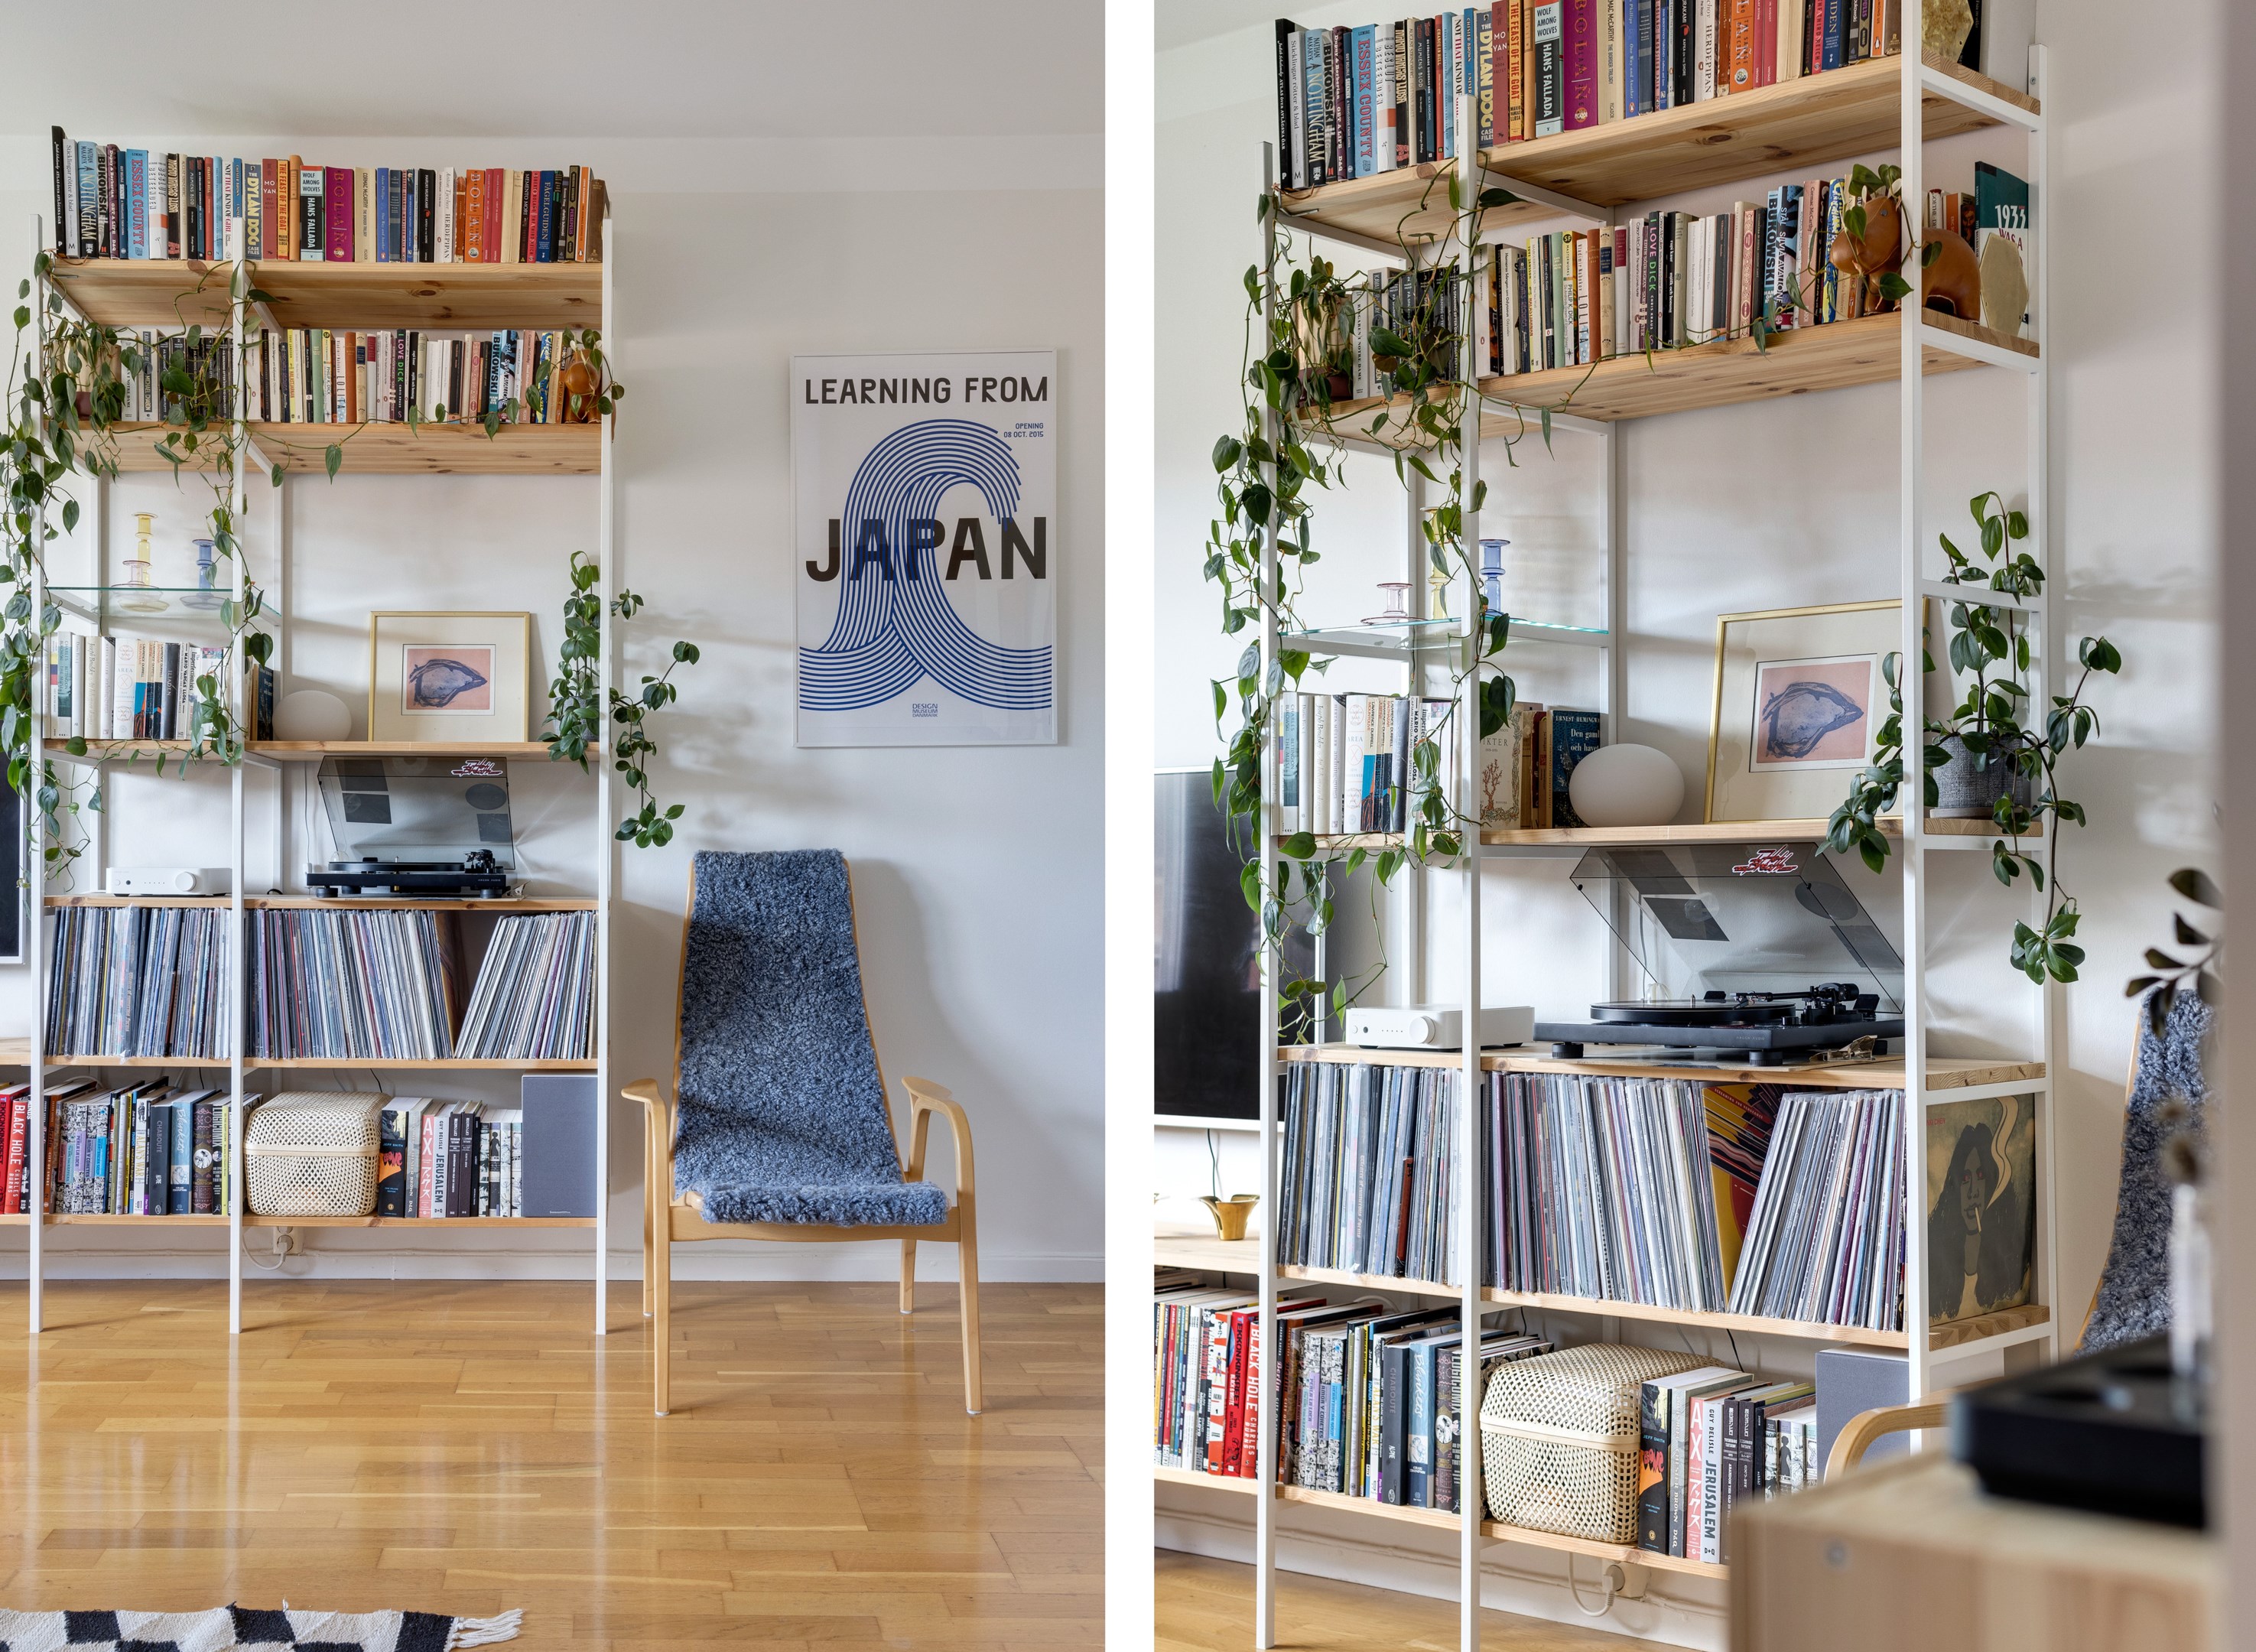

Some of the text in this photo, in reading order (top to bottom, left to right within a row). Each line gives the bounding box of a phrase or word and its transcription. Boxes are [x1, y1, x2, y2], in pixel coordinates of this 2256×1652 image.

[1491, 43, 1507, 52] YAN
[1537, 16, 1557, 26] AMONG
[1394, 29, 1406, 105] MARIO VARGAS LLOSA
[1479, 31, 1493, 86] DYLAN
[1510, 3, 1520, 99] THE FEAST OF THE GOAT
[1324, 45, 1334, 127] BUKOWSKI
[1358, 38, 1372, 158] ESSEX COUNTY
[1543, 44, 1552, 117] HANS FALLADA
[1307, 73, 1325, 162] NOTTINGHAM
[1480, 89, 1493, 128] DOG
[80, 174, 96, 239] NOTTINGHAM
[98, 157, 106, 216] BUKOWSKI
[132, 159, 144, 246] ESSEX COUNTY
[168, 159, 178, 213] MARIO VARGAS LLOSA
[247, 177, 261, 216] DYLAN
[541, 182, 551, 240] FÅGELGUIDEN
[248, 219, 259, 246] DOG
[1765, 198, 1778, 285] BUKOWSKI
[1994, 204, 2026, 229] 1933
[1578, 295, 1589, 343] LOLITA
[490, 337, 500, 392] BUKOWSKI
[806, 376, 1048, 405] LEARNING FROM
[805, 516, 1047, 582] JAPAN
[1571, 729, 1583, 737] Den
[10, 1105, 25, 1165] BLACK HOLE
[177, 1108, 187, 1153] Blankets
[213, 1107, 223, 1147] LOGICOMIX
[135, 1136, 145, 1176] ALAN'S WAR
[434, 1153, 445, 1202] JERUSALEM
[1234, 1316, 1243, 1409] TEKKONKINKREET
[1413, 1353, 1425, 1418] Blankets
[1246, 1377, 1258, 1412] HOLE
[1248, 1417, 1257, 1455] CHARLES
[1704, 1460, 1717, 1539] JERUSALEM
